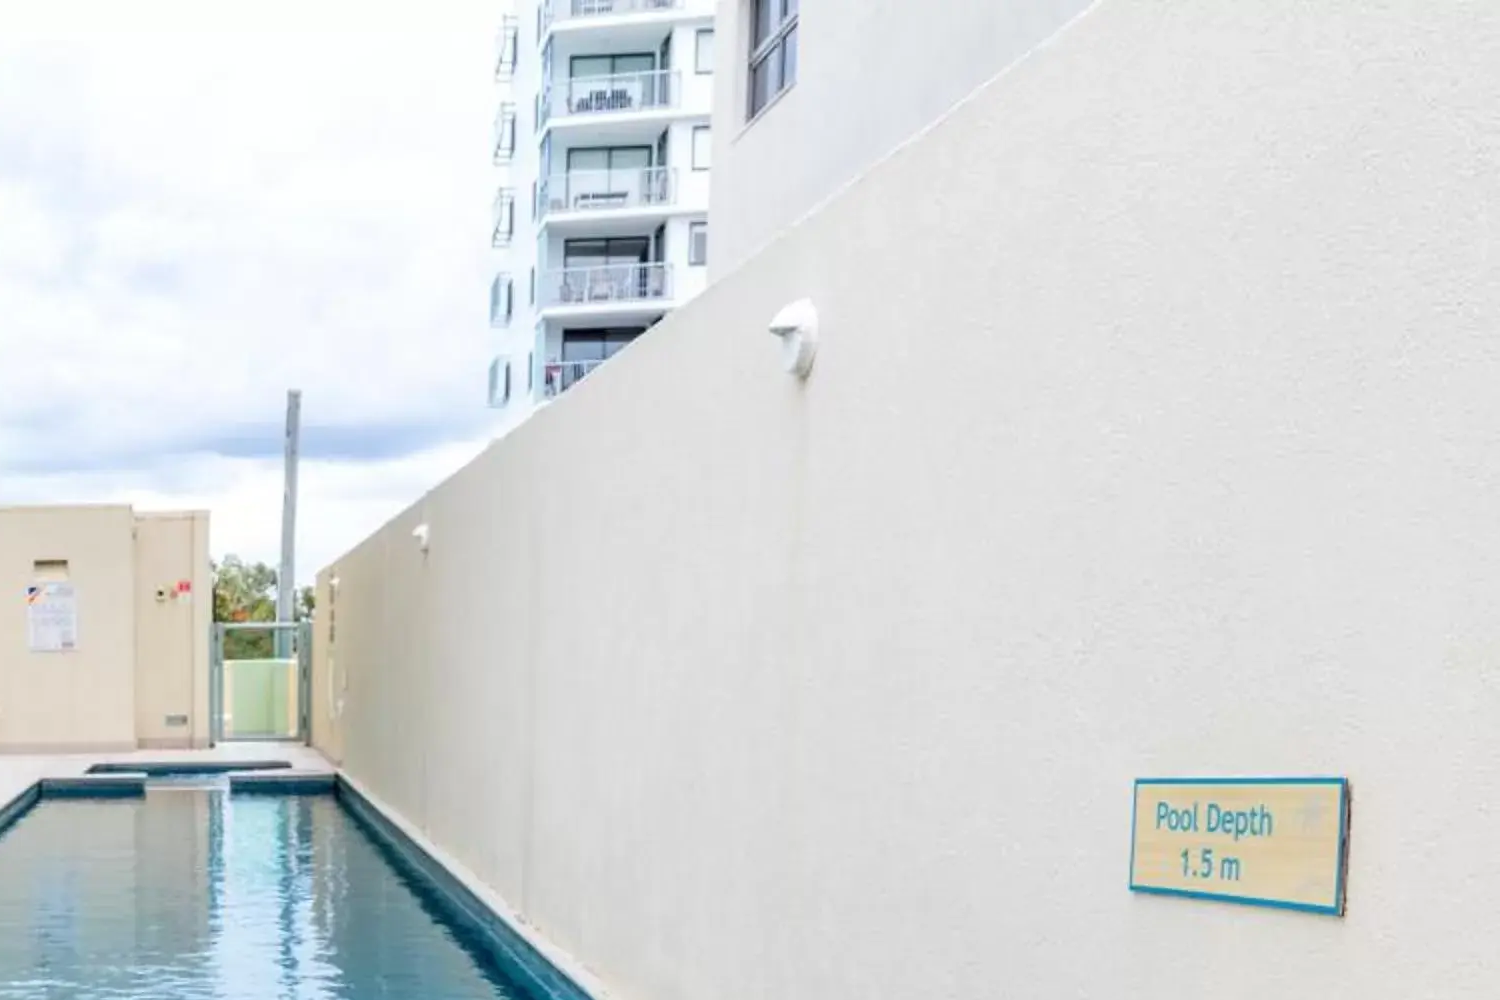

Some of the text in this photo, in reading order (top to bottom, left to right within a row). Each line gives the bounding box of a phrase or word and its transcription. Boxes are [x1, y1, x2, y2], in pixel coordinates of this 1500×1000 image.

[1156, 801, 1273, 841] Pool Depth
[1180, 848, 1240, 880] 1.5 m
